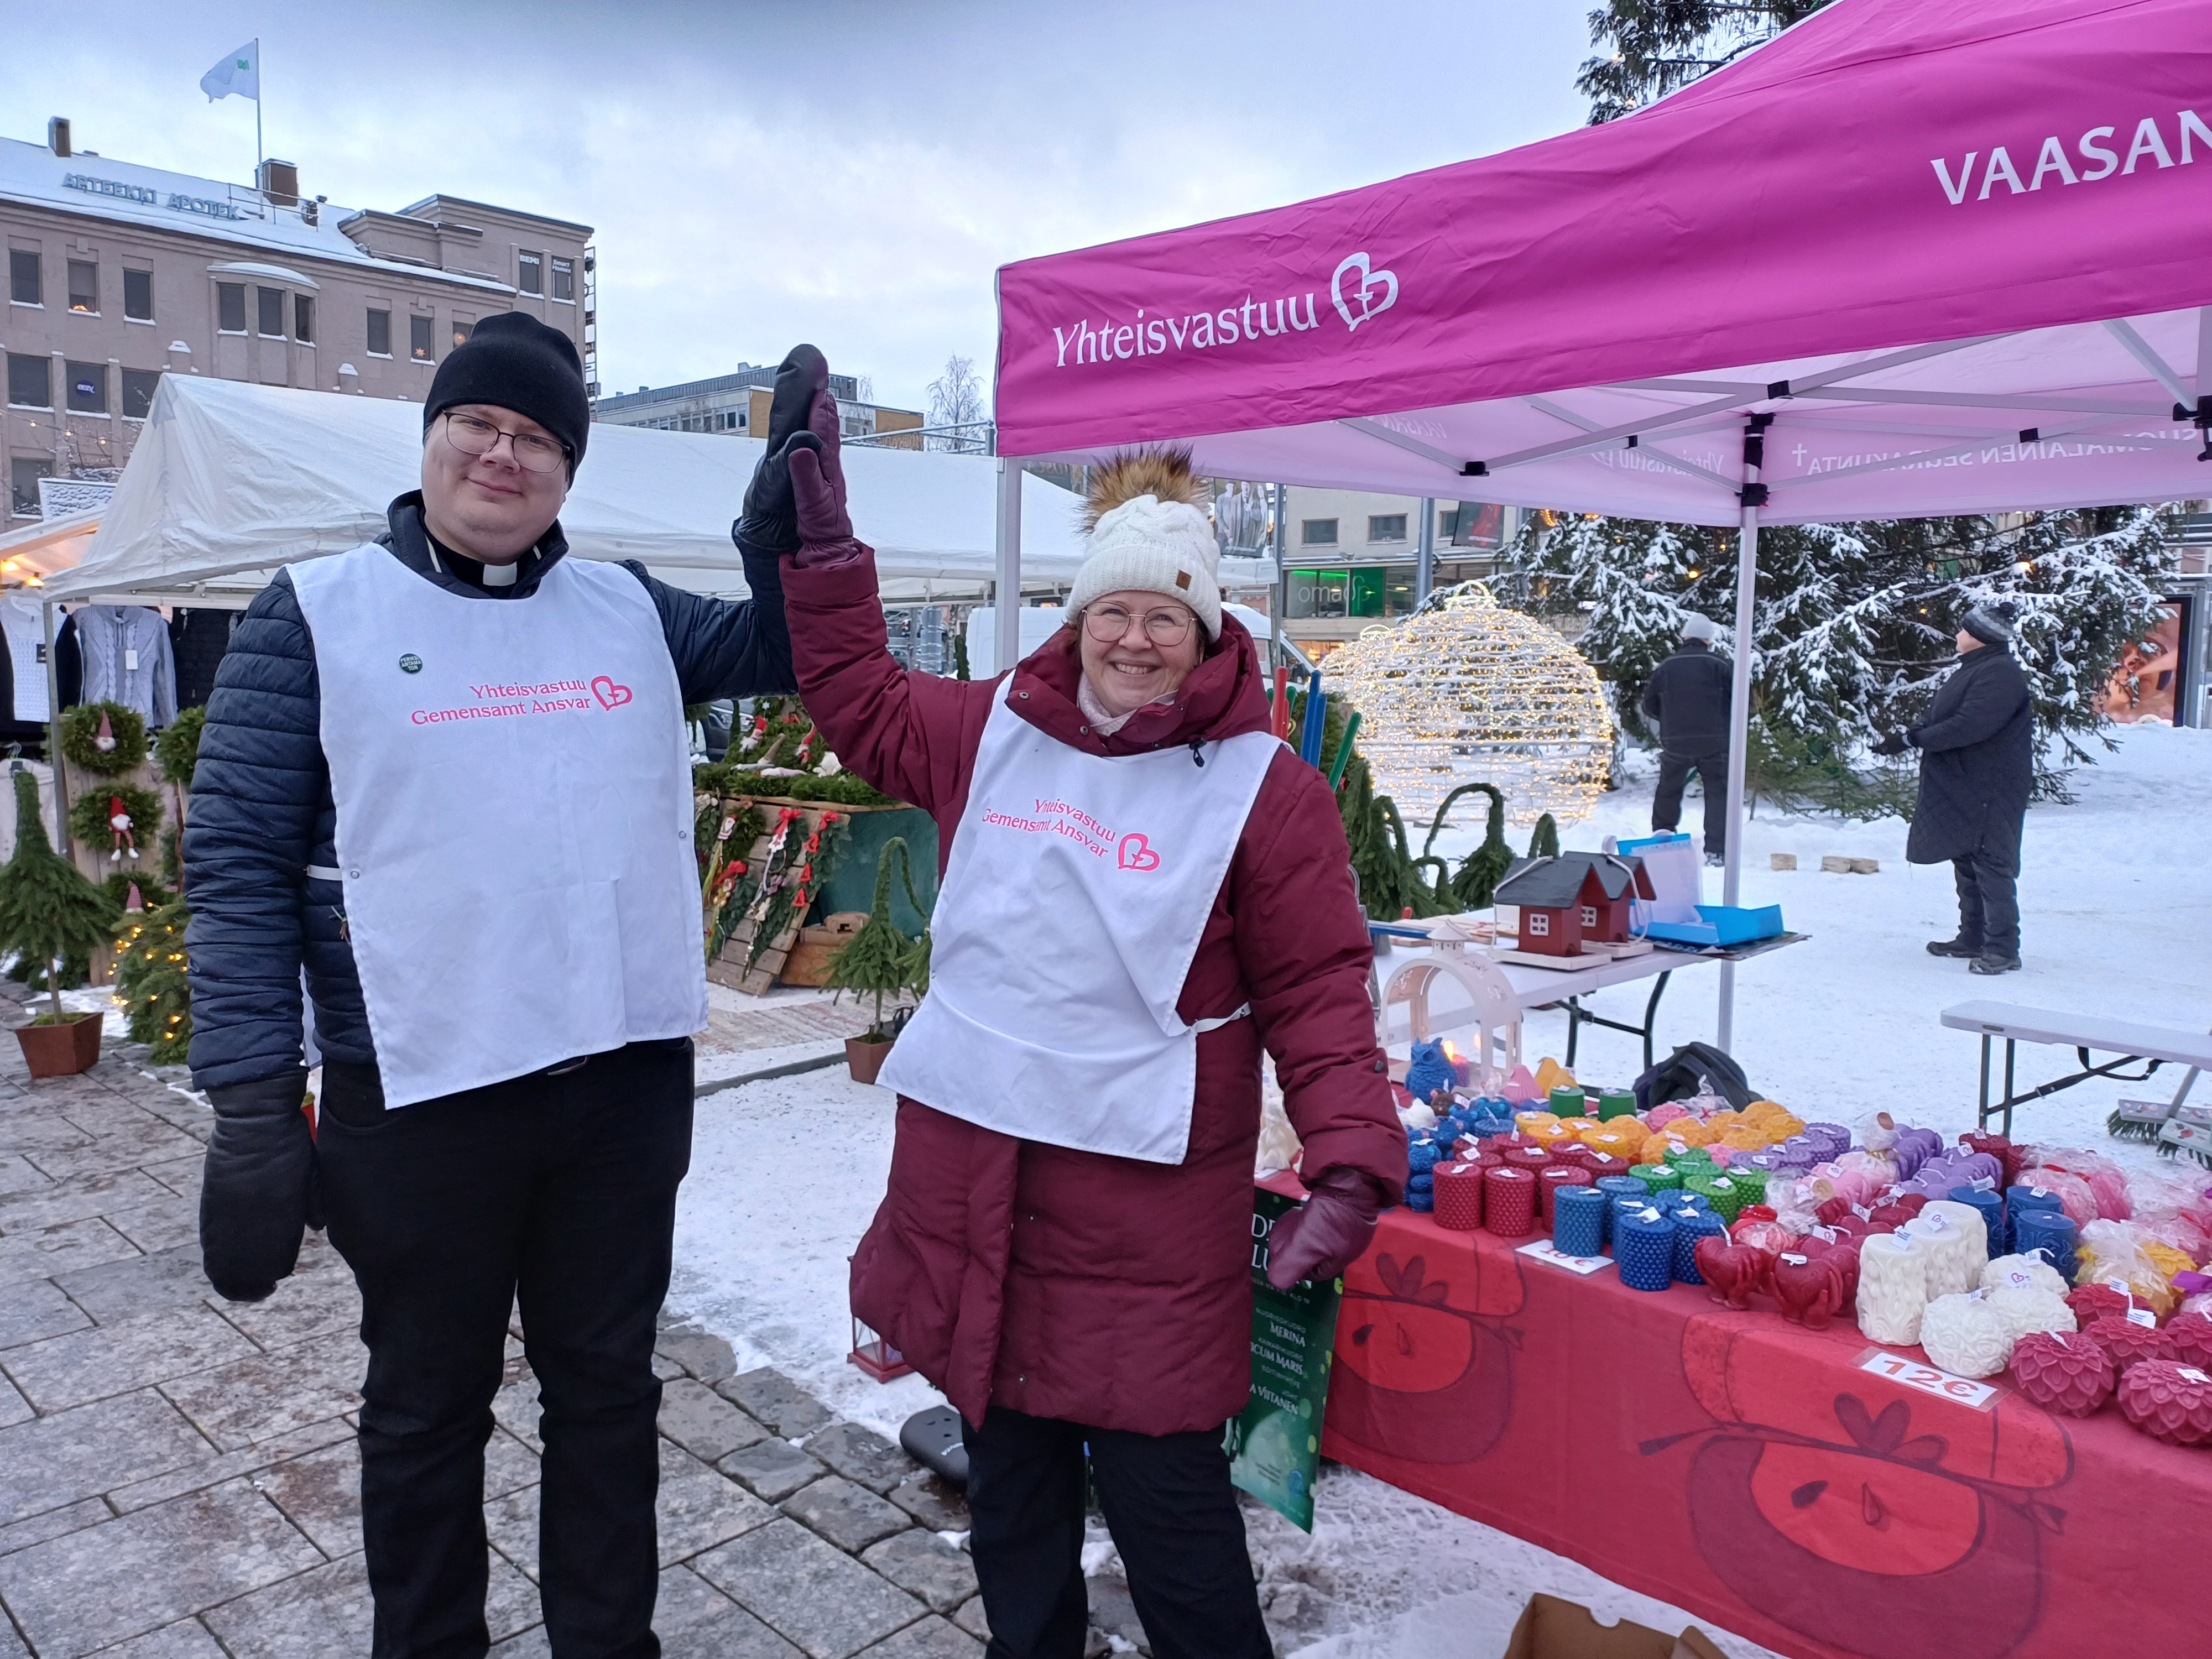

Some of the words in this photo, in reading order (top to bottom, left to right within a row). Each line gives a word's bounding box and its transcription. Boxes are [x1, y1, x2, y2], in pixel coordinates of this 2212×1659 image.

[1930, 109, 2212, 205] VAASAN
[62, 173, 157, 204] APTEEKKI
[168, 193, 241, 220] APOTEK
[1053, 293, 1320, 367] Yhteisvastuu
[470, 680, 587, 699] Yhteisvastuu
[411, 701, 525, 725] Gemensamt
[531, 696, 591, 713] Ansvar
[1051, 819, 1109, 858] Ansvar
[1884, 1360, 1979, 1397] 12€
